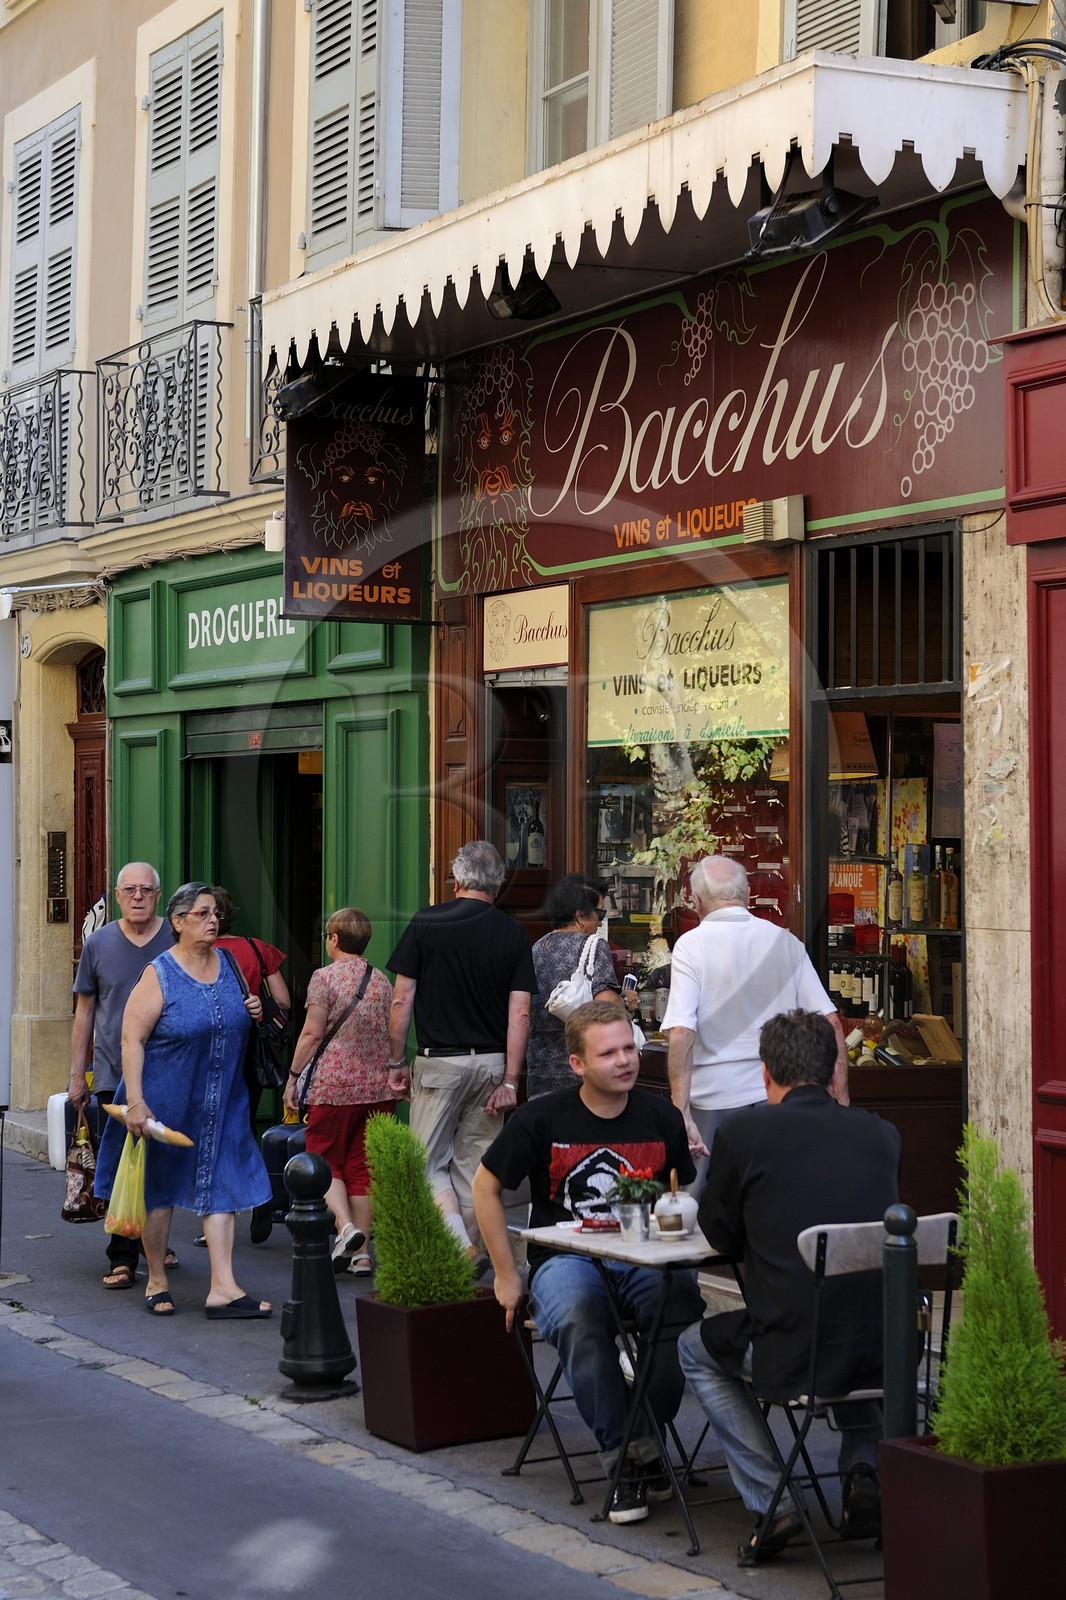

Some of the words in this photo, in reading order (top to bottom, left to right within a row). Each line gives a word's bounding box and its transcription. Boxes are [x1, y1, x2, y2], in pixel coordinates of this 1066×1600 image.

[528, 250, 899, 518] Bacchus
[614, 518, 650, 549] VINS
[656, 514, 672, 541] et
[677, 498, 757, 539] LIQUEUR
[301, 556, 363, 577] VINS
[382, 562, 402, 579] et
[293, 580, 411, 604] LIQUEURS
[513, 610, 568, 645] Bacchus
[637, 598, 737, 661] Bacchus
[613, 673, 648, 696] VINS
[656, 668, 675, 693] et
[683, 660, 763, 693] LIQUEURS
[684, 723, 692, 739] à
[829, 872, 863, 891] PLANQUE
